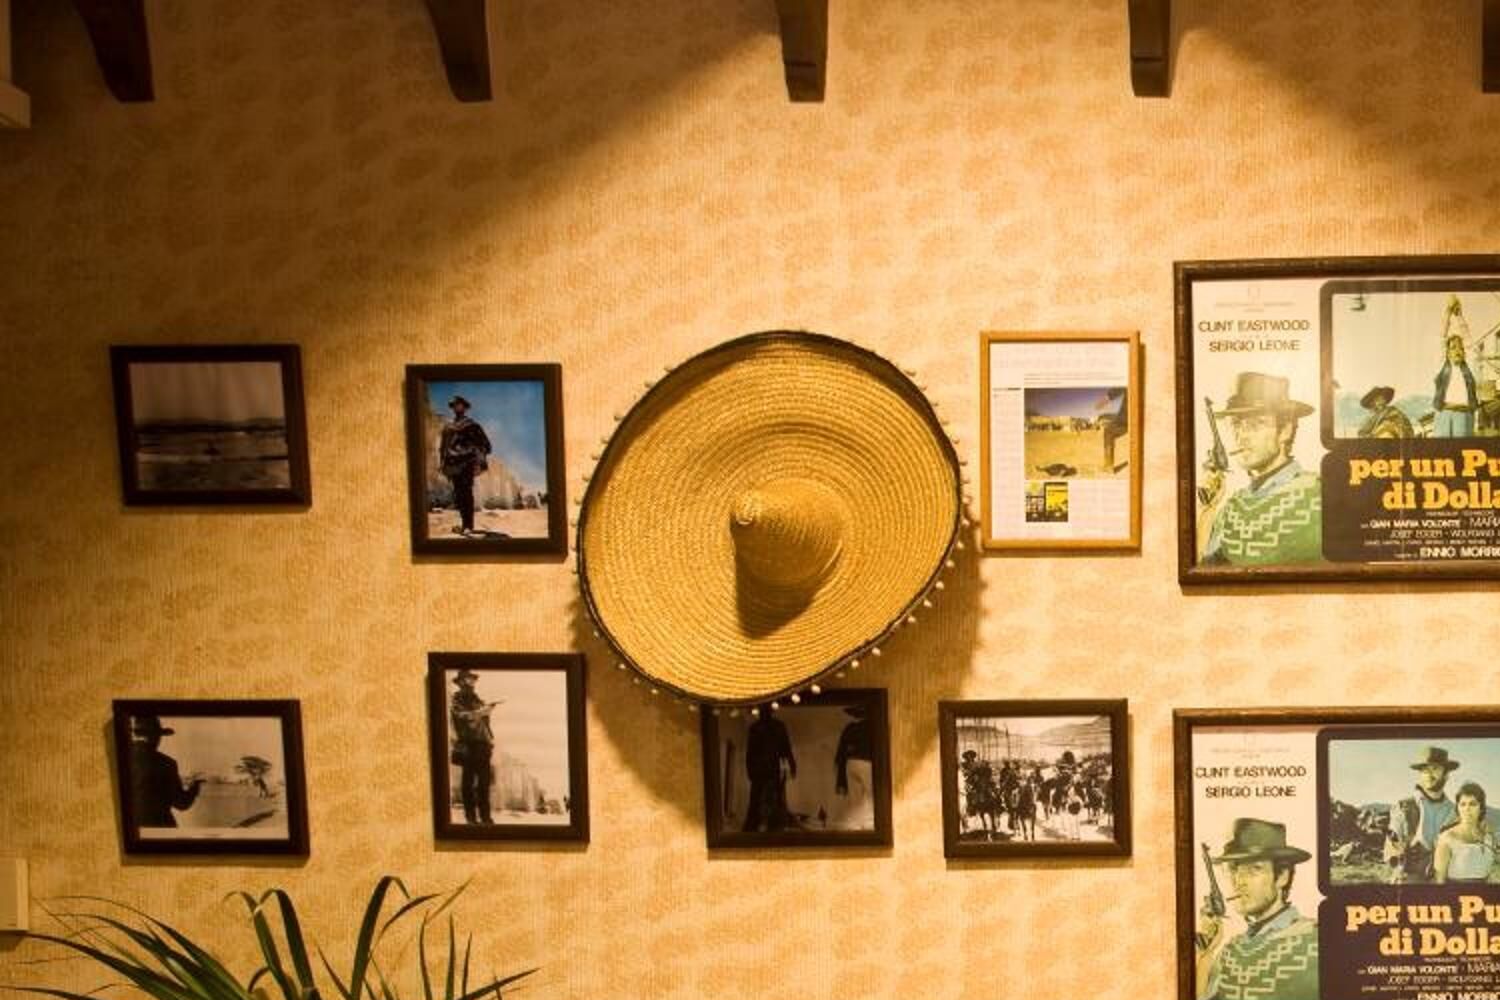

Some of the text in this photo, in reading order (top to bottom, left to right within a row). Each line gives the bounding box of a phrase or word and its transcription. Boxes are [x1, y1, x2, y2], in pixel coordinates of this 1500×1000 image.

[1198, 319, 1310, 332] CLINT EASTWOOD
[1209, 339, 1301, 352] SERGIO LEONE
[1349, 459, 1405, 485] per
[1410, 458, 1456, 478] un
[1382, 481, 1417, 509] di
[1419, 546, 1456, 558] ENNIO
[1195, 765, 1307, 778] CLINT EASTWOOD
[1205, 785, 1297, 798] SERGIO LEONE
[1345, 904, 1401, 931] per
[1407, 904, 1453, 924] un
[1379, 927, 1414, 956] di
